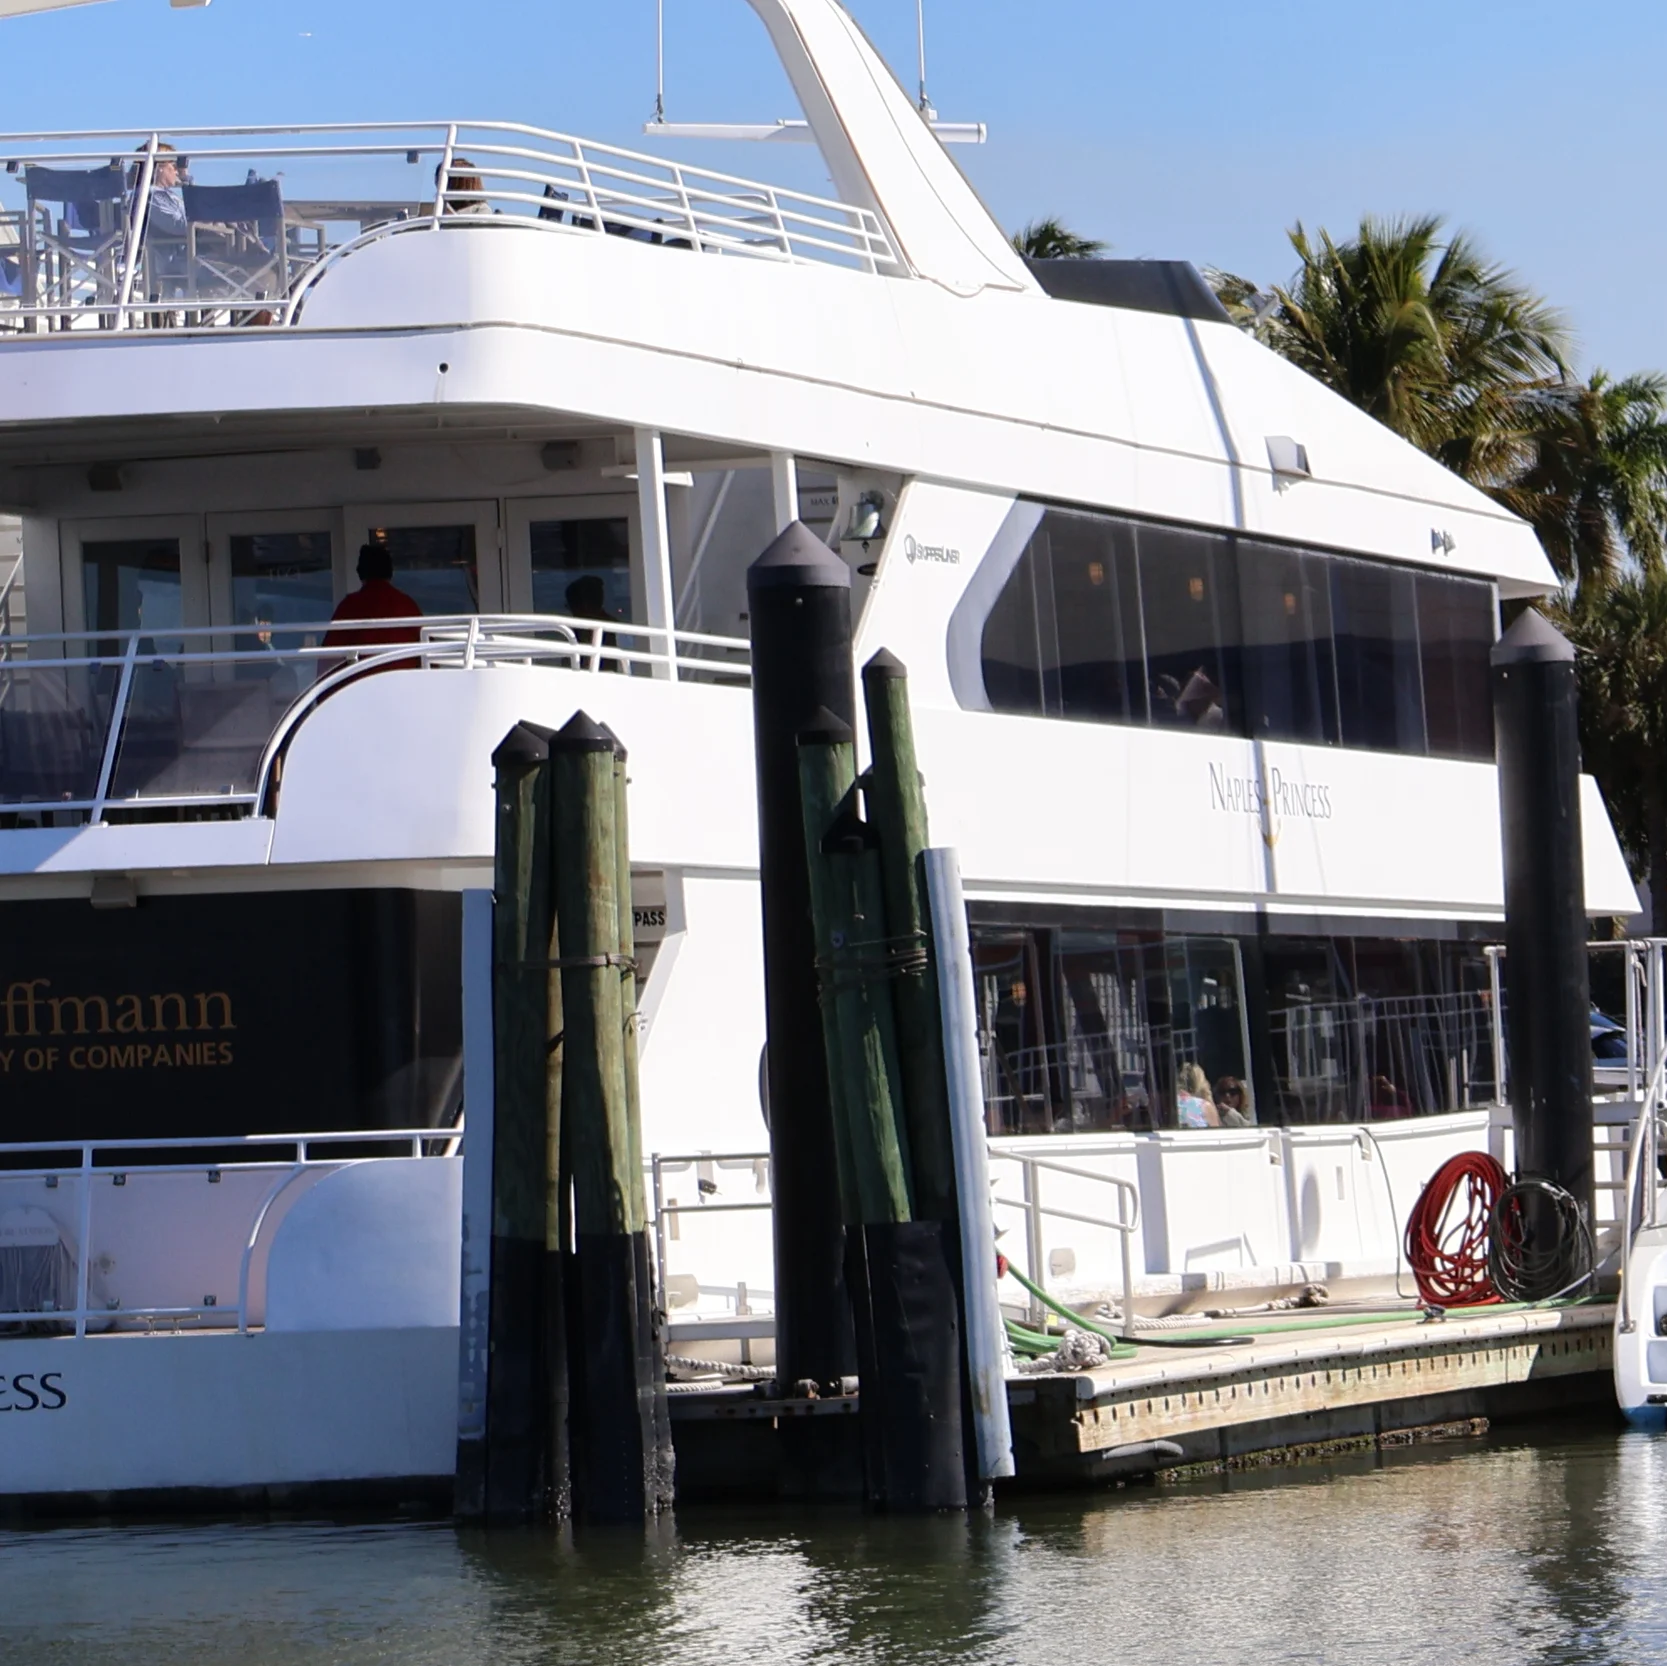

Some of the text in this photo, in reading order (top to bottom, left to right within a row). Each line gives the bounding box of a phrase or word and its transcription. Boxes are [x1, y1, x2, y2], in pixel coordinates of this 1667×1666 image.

[1271, 767, 1332, 819] PRINCESS
[634, 911, 665, 927] PASS
[24, 1046, 60, 1072] OF
[69, 1041, 235, 1070] COMPANIES
